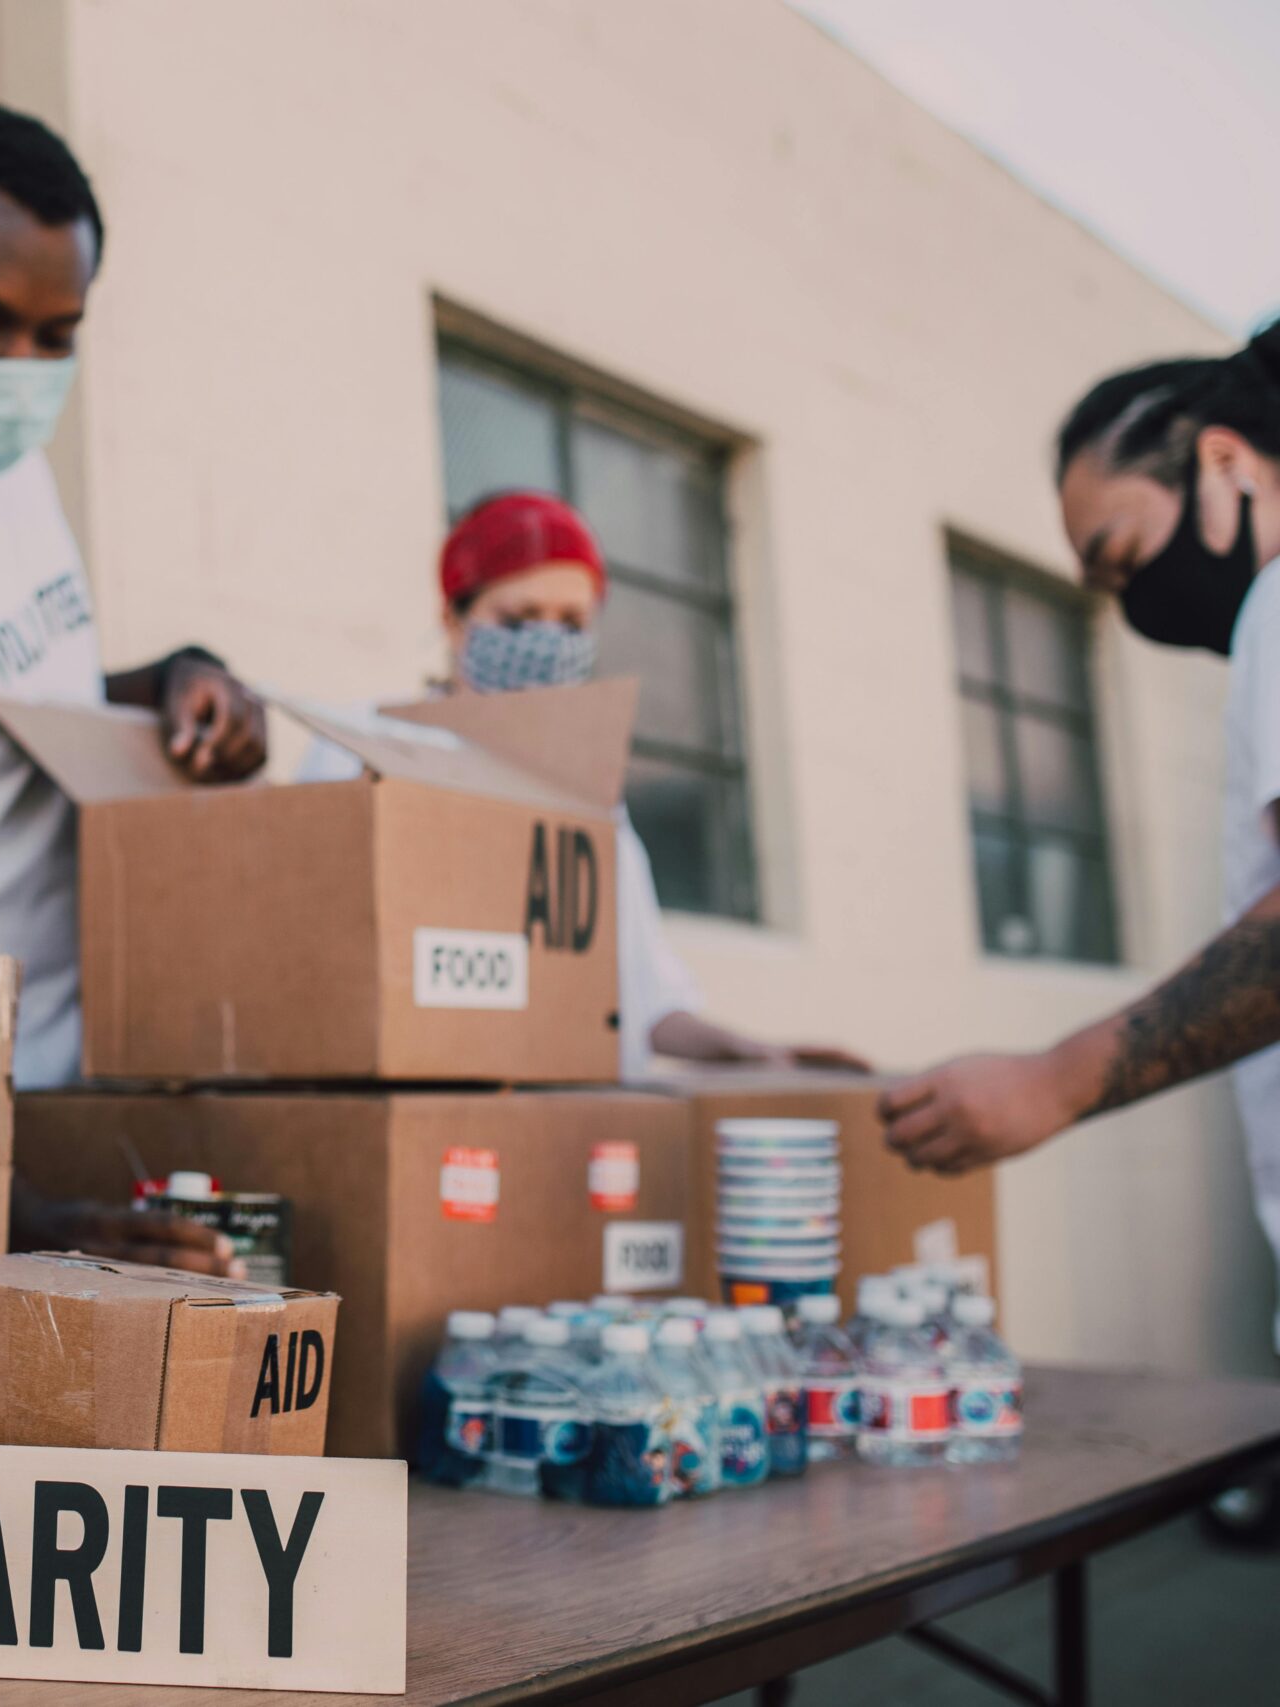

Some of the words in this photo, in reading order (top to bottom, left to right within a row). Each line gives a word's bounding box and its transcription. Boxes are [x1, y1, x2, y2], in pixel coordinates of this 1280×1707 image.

[525, 820, 597, 954] AID
[432, 945, 511, 989] FOOD
[250, 1329, 325, 1418] AID
